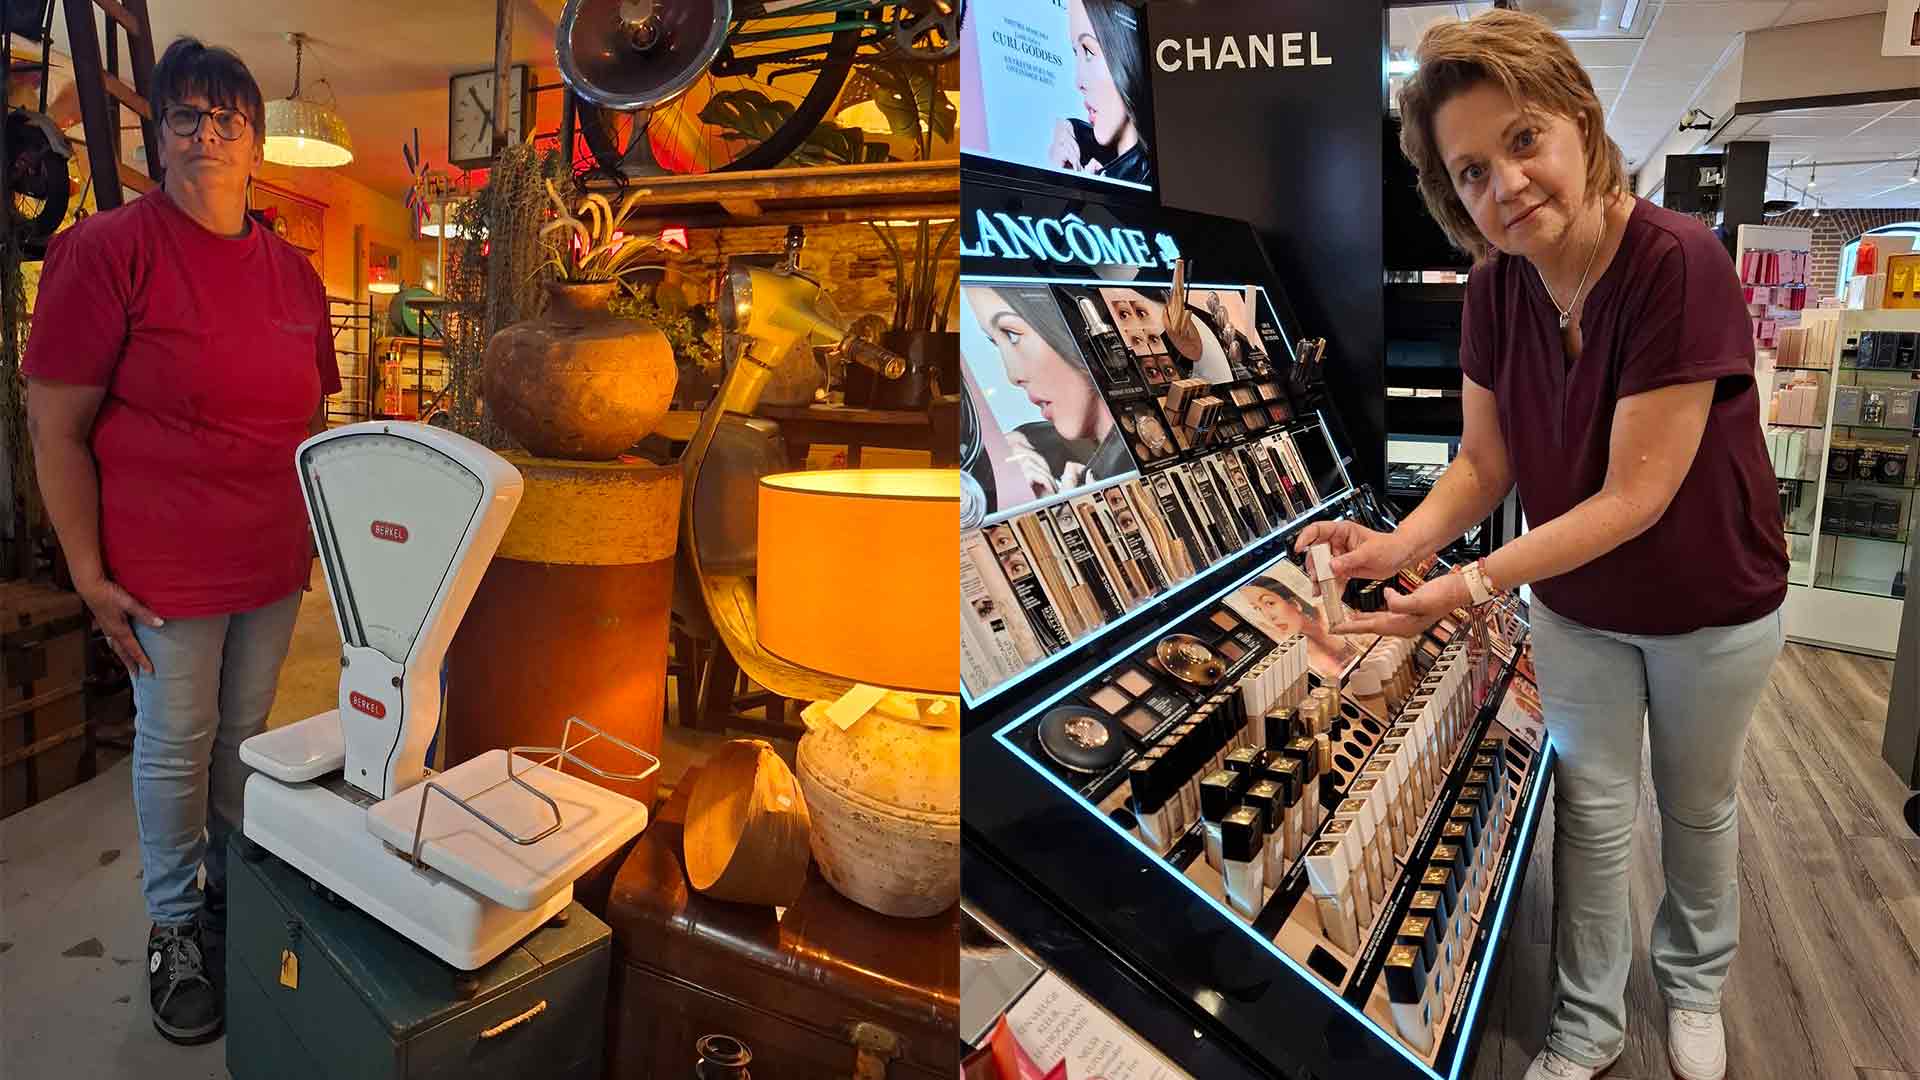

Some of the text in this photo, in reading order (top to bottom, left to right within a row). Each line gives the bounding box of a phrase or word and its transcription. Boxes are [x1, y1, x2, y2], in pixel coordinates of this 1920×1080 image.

[992, 31, 1020, 51] CURL
[1021, 41, 1063, 66] GODDESS
[1156, 32, 1332, 72] CHANEL
[375, 524, 404, 539] BERKEL
[352, 695, 380, 715] BERKEL
